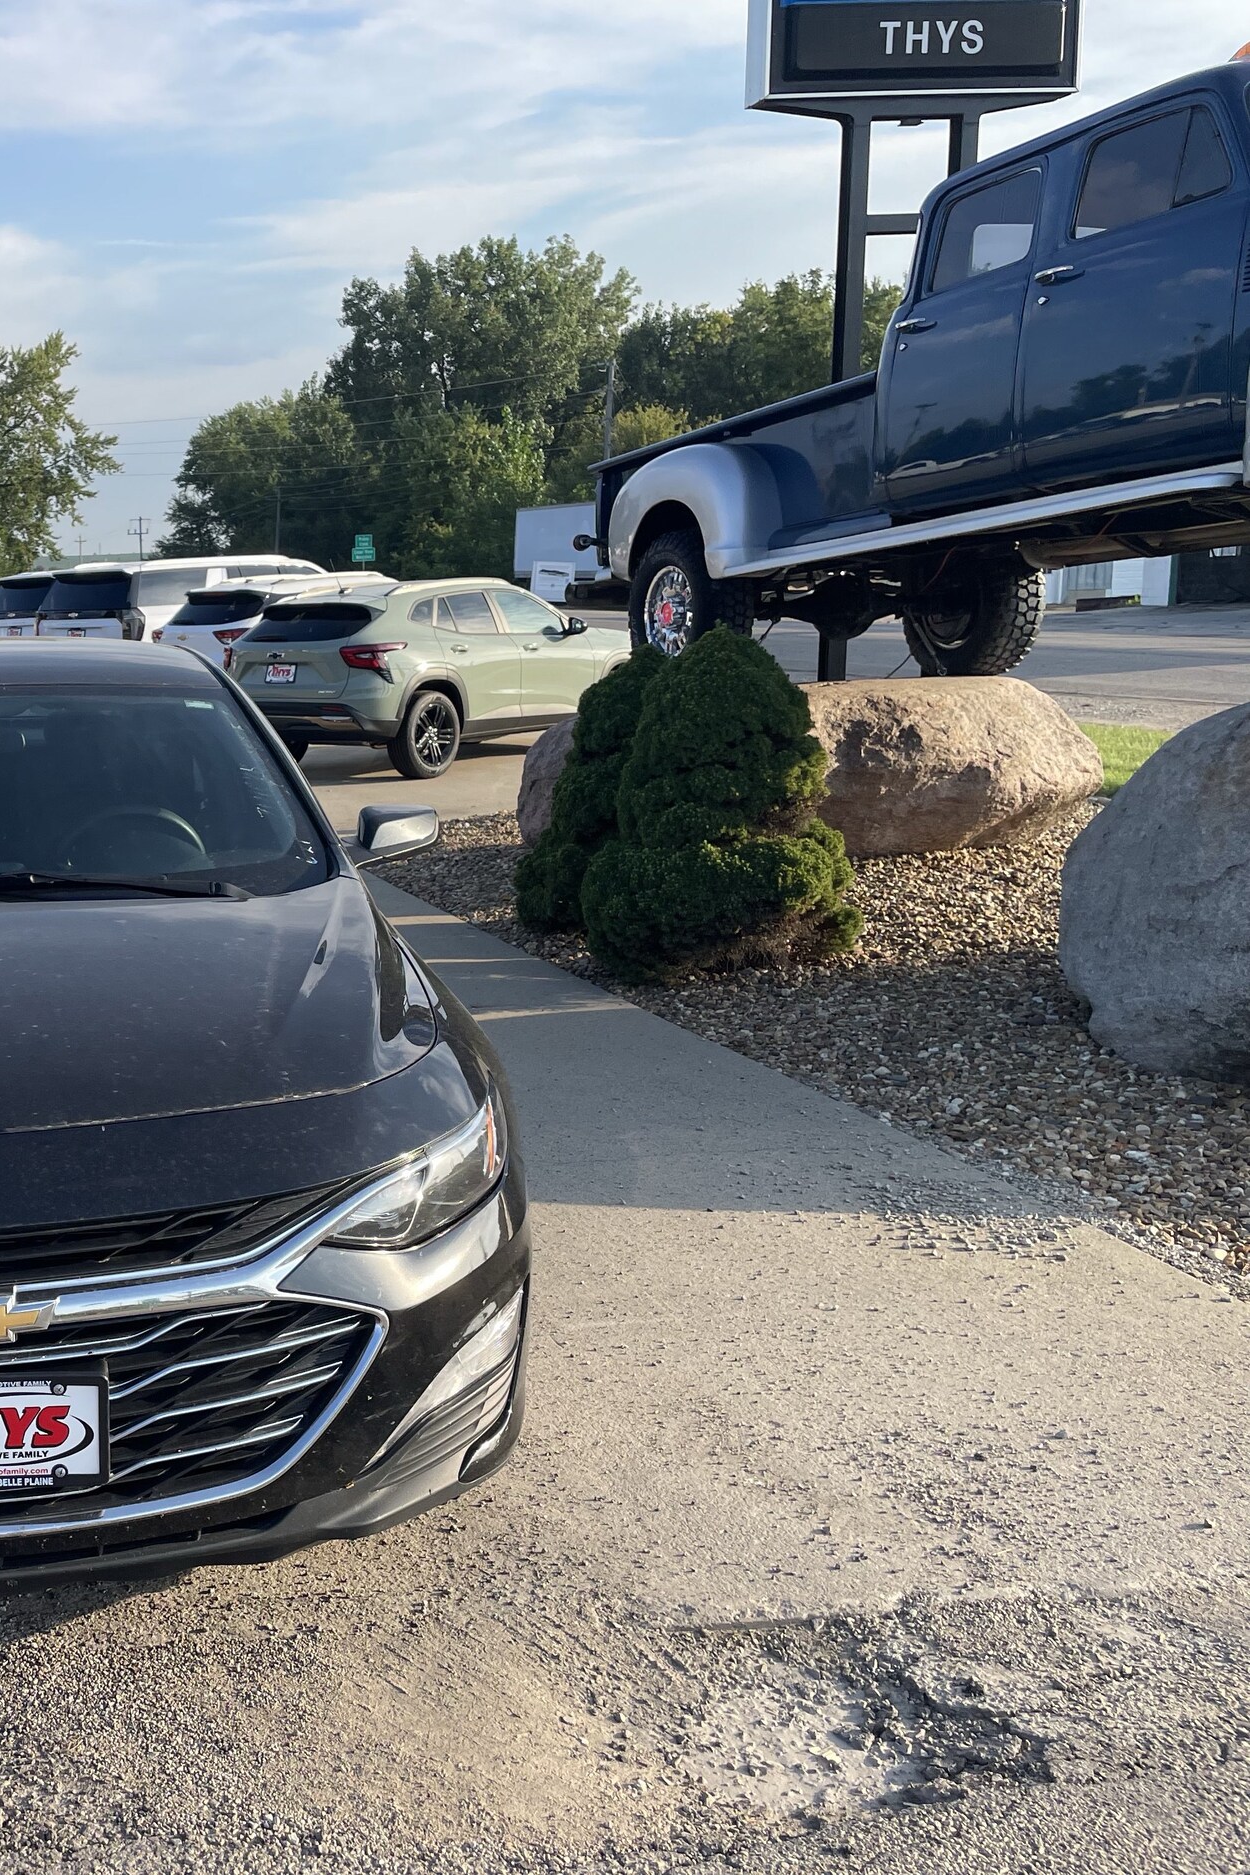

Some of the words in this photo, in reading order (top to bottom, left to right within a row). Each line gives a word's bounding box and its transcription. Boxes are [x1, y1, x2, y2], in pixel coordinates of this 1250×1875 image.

[879, 20, 984, 55] THYS
[12, 1450, 49, 1459] FAMILY
[24, 1477, 54, 1486] PLAINE
